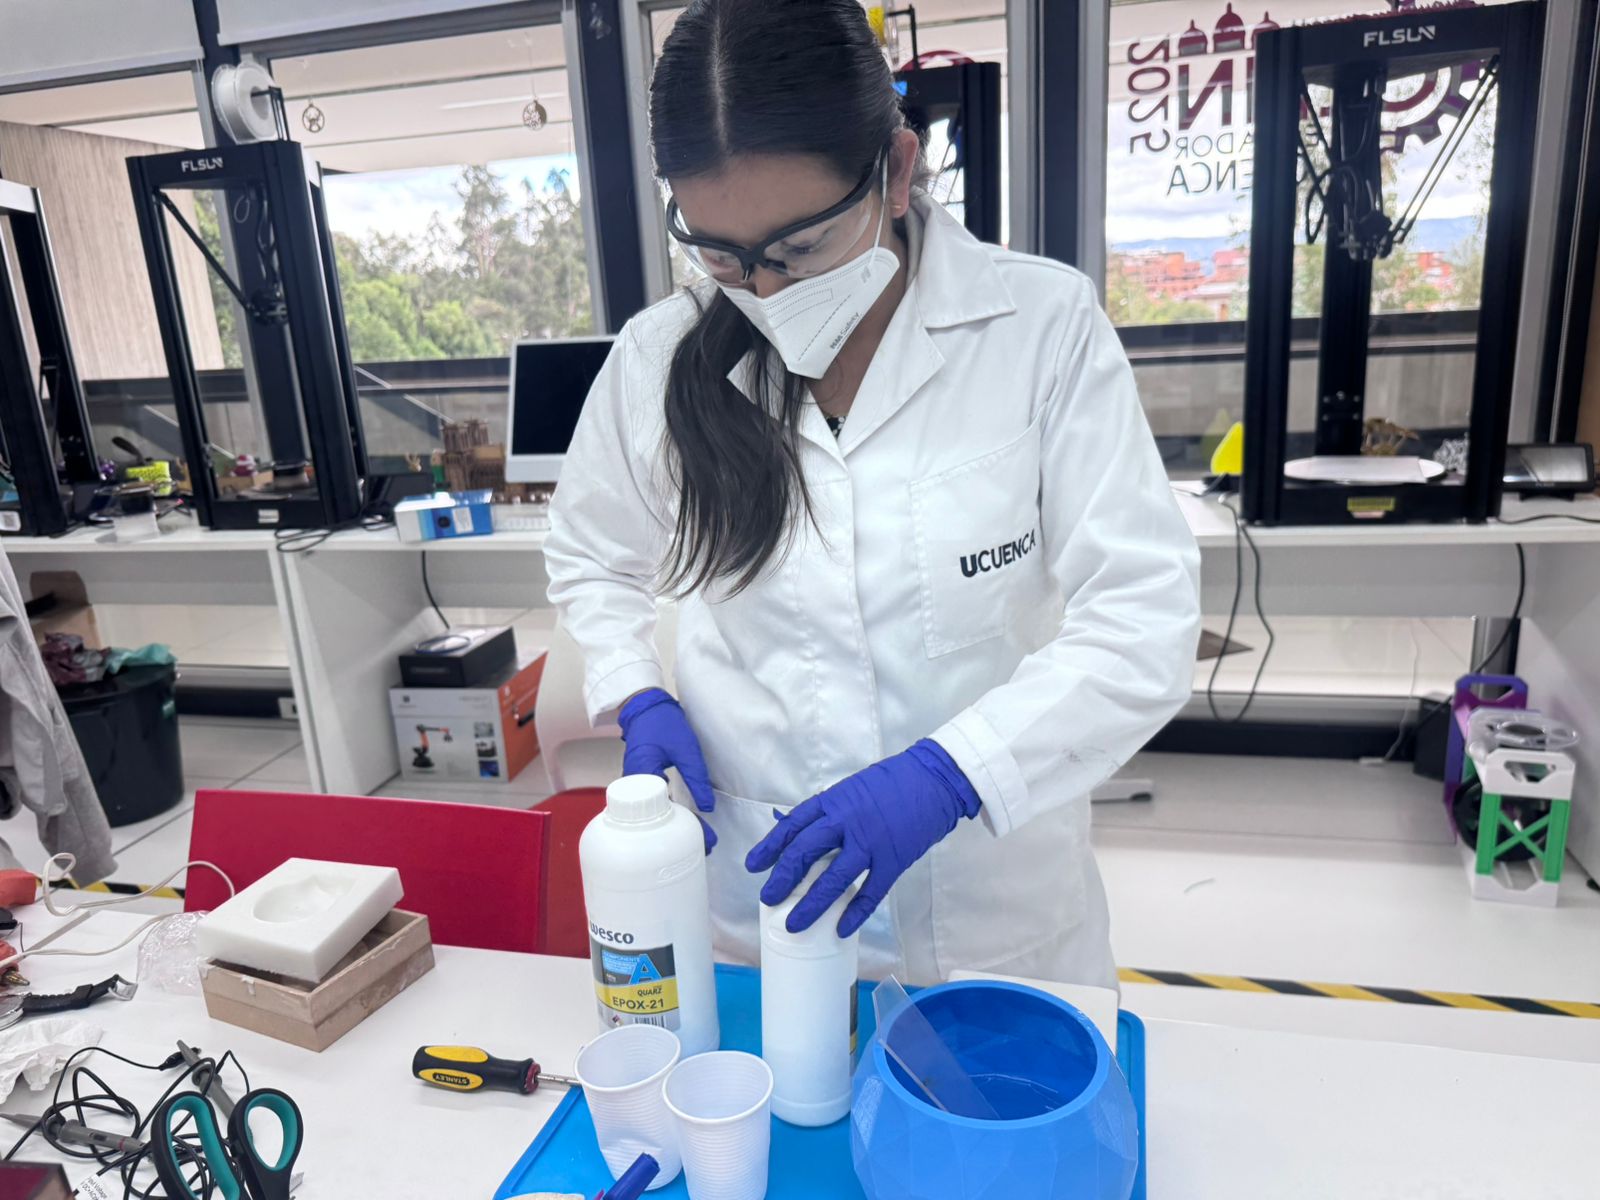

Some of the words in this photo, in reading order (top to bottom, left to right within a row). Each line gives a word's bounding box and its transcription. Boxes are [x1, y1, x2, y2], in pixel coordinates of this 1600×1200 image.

[960, 528, 1036, 577] UCUENCA
[591, 923, 634, 944] wesco
[629, 953, 662, 985] A
[637, 987, 662, 997] QUARZ
[612, 996, 664, 1010] EPOX-21
[435, 1073, 467, 1085] STANLEY
